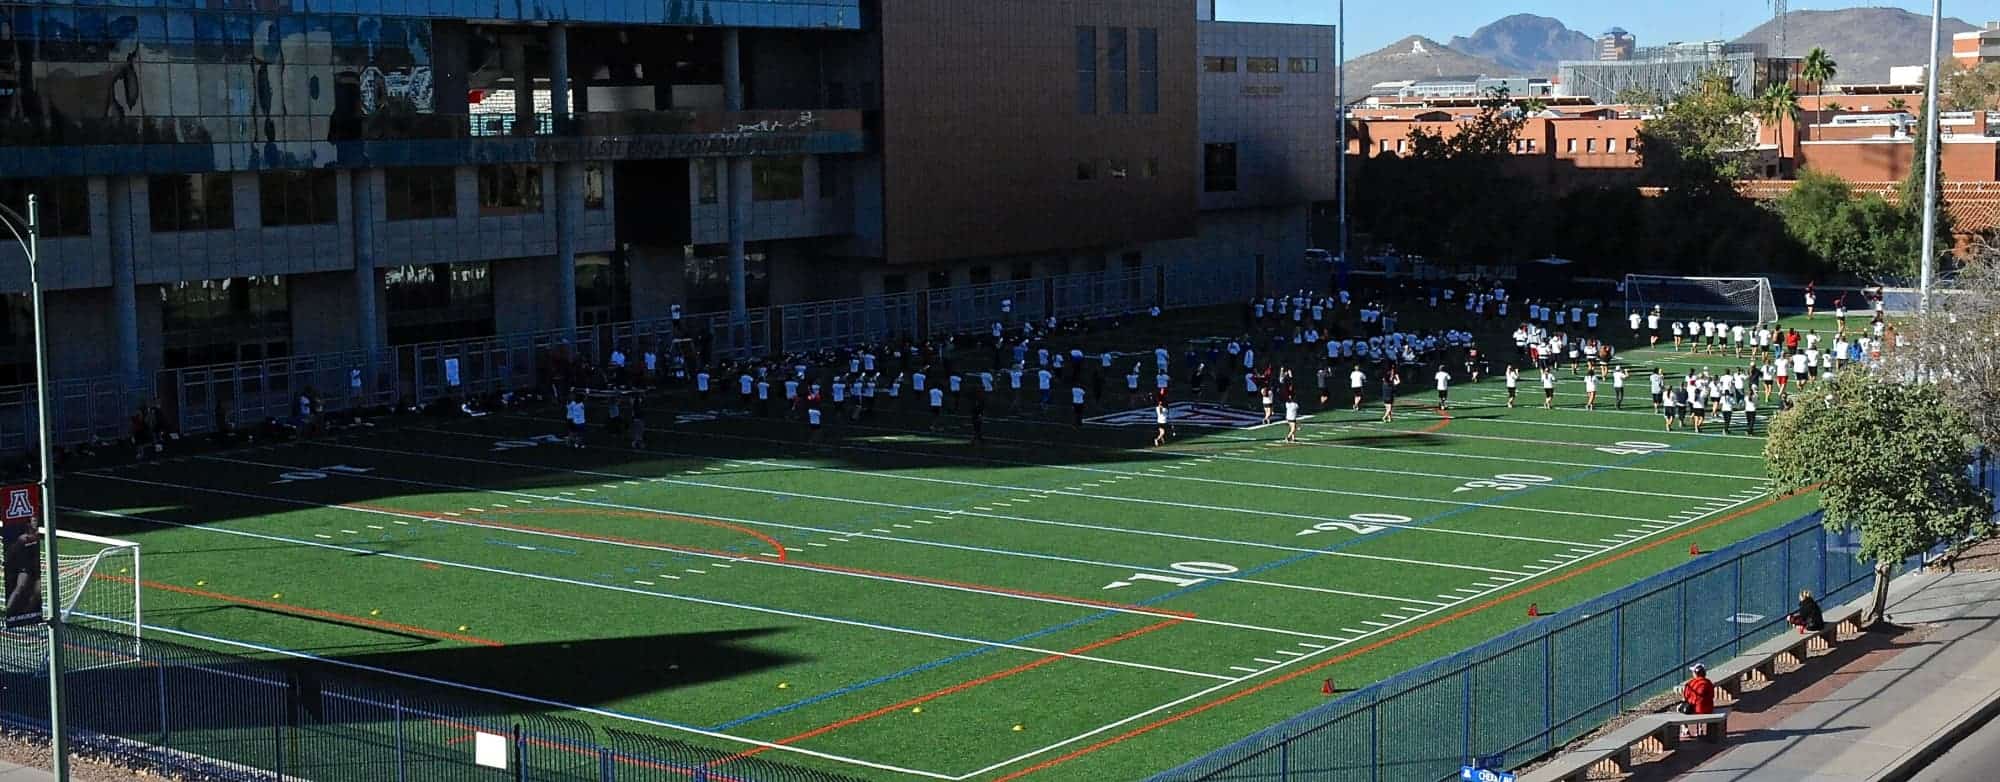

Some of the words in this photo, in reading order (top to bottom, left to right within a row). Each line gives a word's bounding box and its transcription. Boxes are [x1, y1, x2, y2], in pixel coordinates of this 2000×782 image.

[1594, 441, 1672, 455] 40
[1464, 474, 1552, 491] 30
[6, 489, 34, 519] A
[1313, 513, 1412, 534] 20
[1128, 561, 1239, 587] 10
